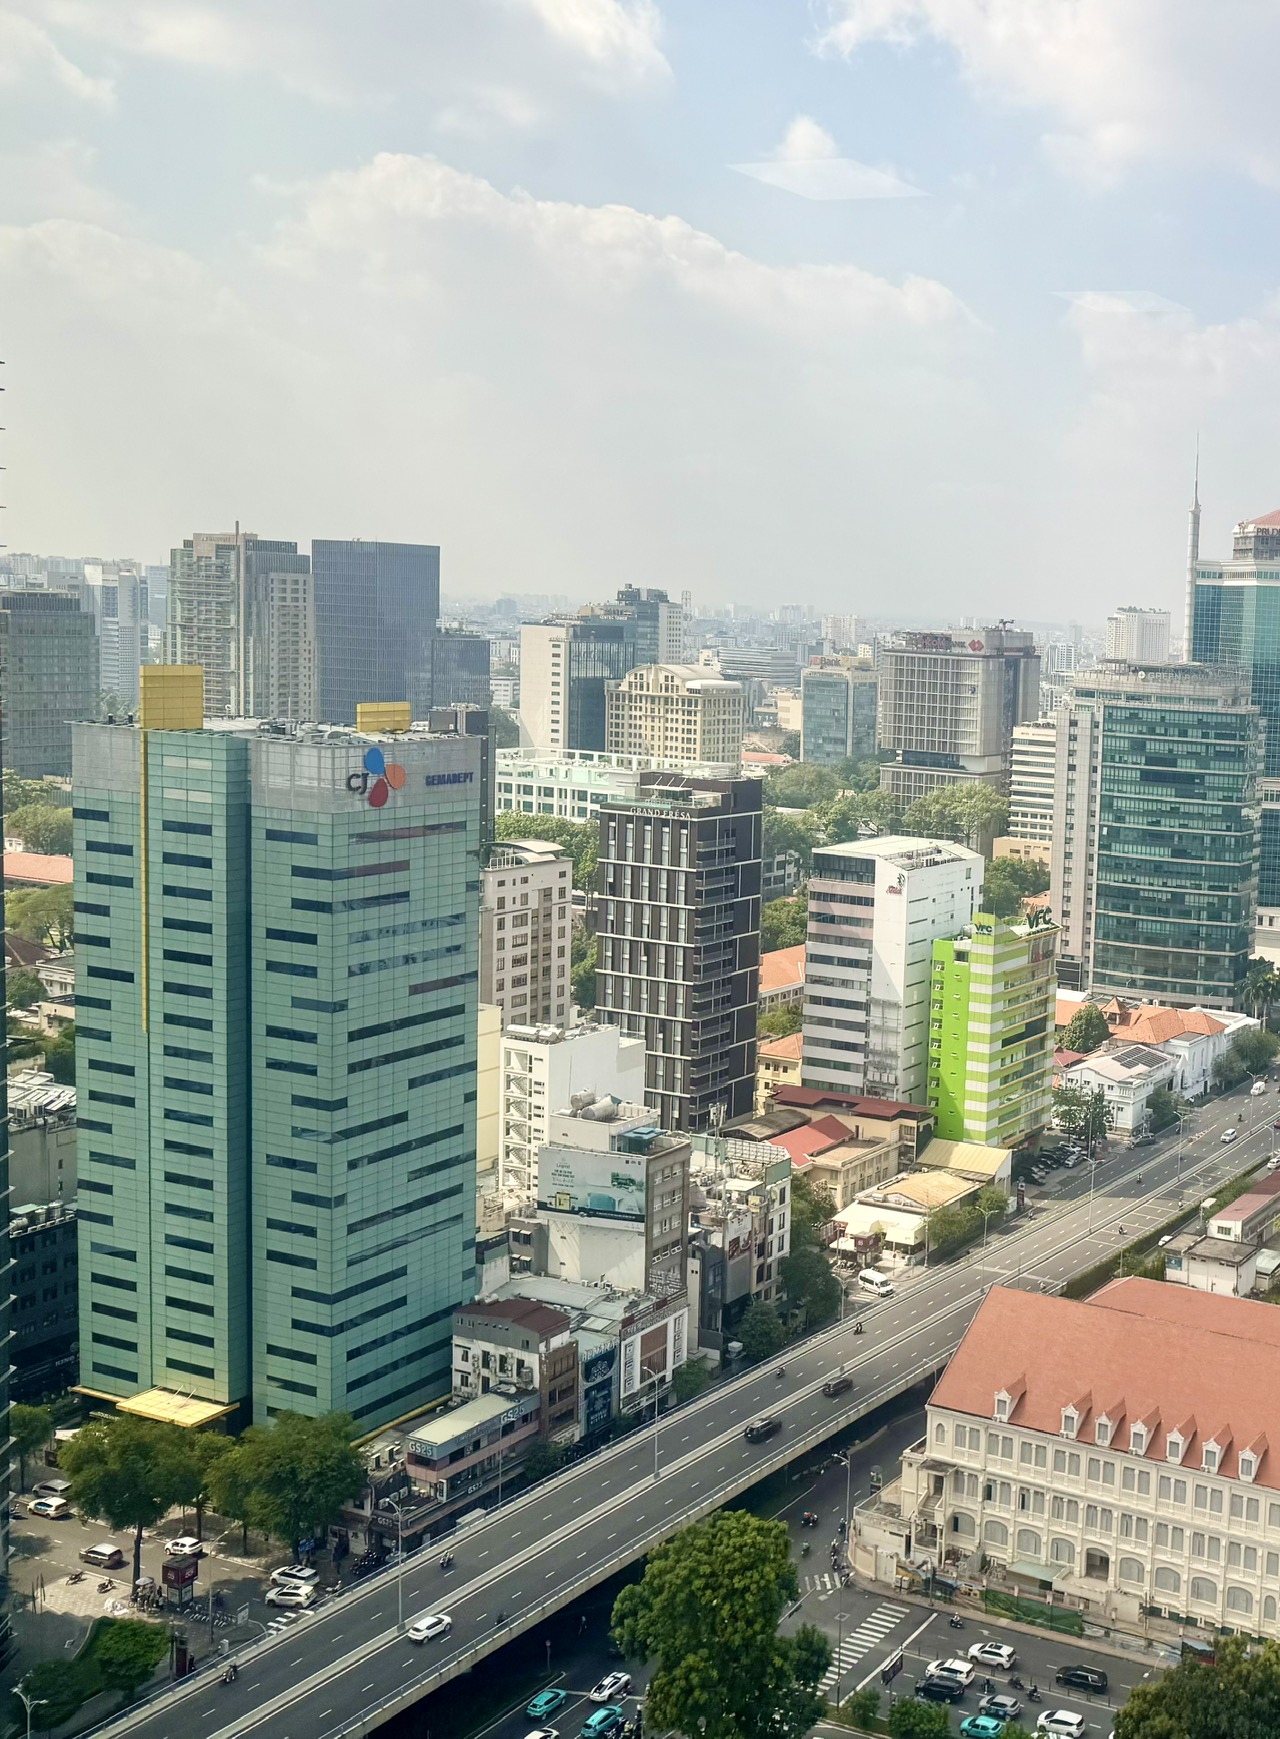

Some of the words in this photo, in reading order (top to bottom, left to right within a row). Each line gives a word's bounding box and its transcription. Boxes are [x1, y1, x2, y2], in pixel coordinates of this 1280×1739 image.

[1148, 671, 1181, 680] GREEN
[347, 772, 370, 795] CJ
[425, 772, 474, 787] GEMADEPT
[630, 806, 661, 817] GRAND
[1026, 906, 1053, 929] VFC
[974, 923, 992, 933] VFC
[500, 1407, 525, 1425] GS25
[409, 1441, 432, 1457] GS25
[467, 1481, 483, 1494] GS25
[378, 1517, 393, 1527] GS25
